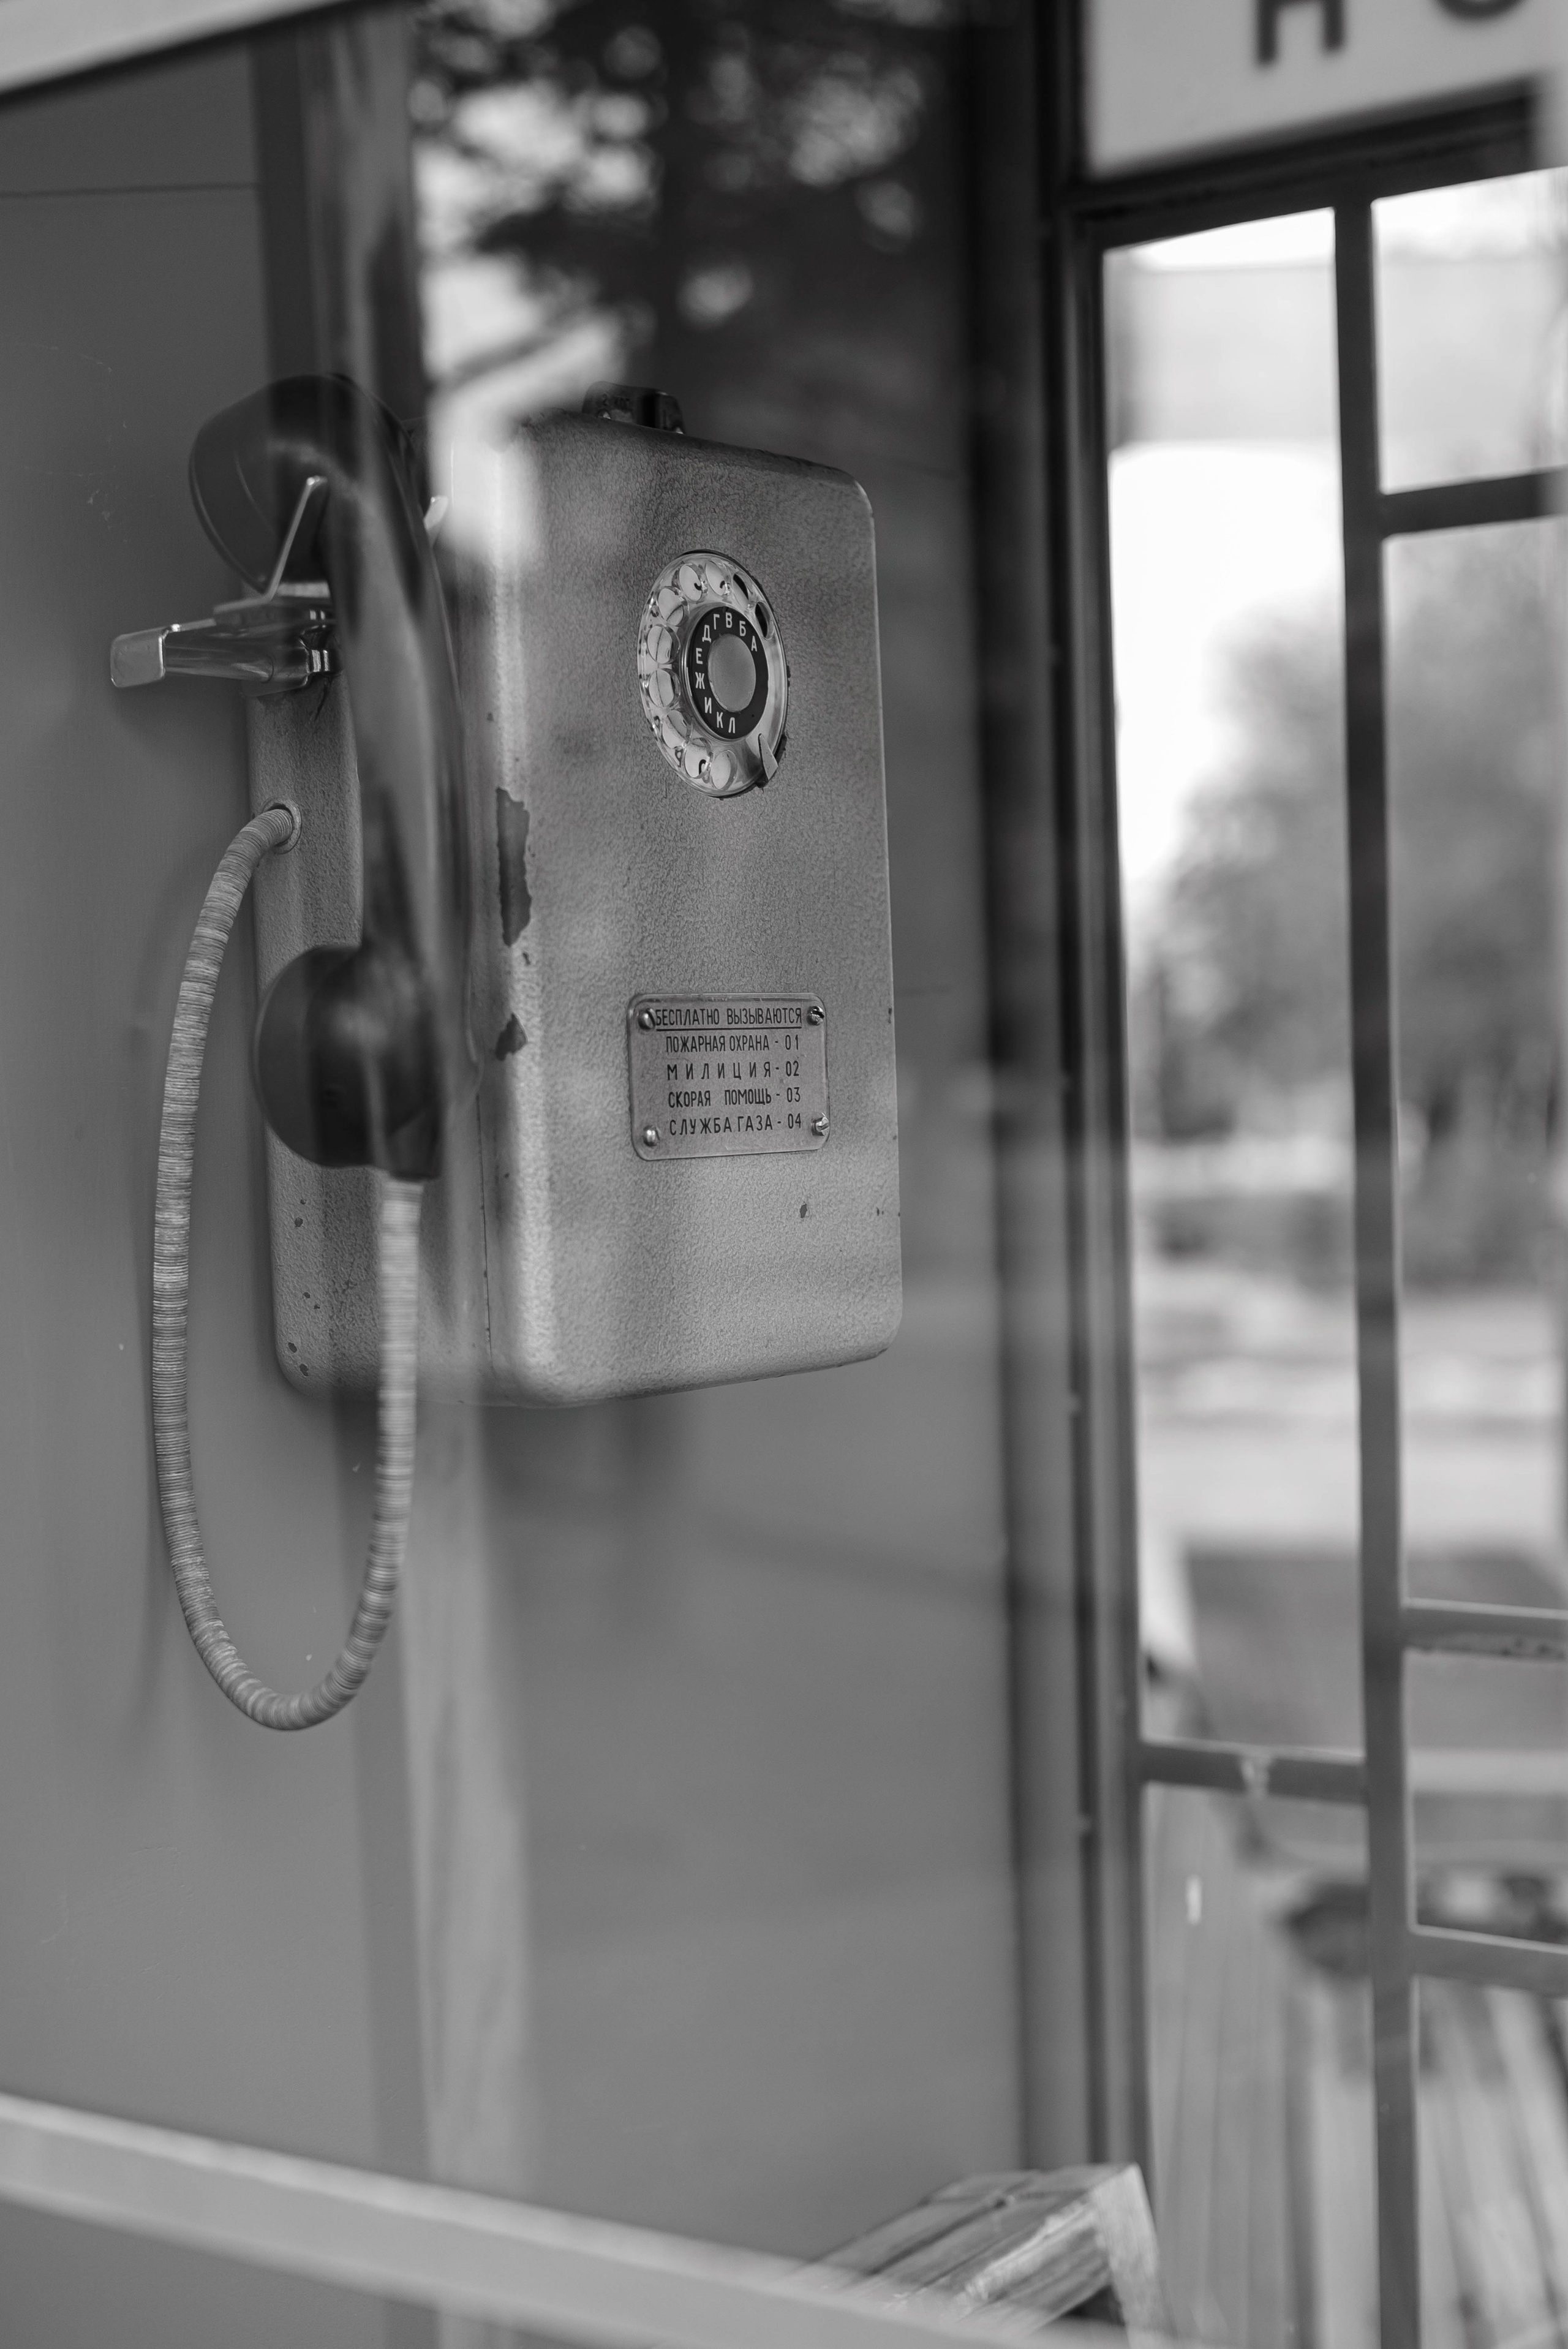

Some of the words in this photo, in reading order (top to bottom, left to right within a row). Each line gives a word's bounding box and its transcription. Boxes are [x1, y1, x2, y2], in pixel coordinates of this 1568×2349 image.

[714, 614, 720, 630] Г
[726, 613, 733, 628] В
[739, 620, 746, 636] Б
[702, 625, 711, 642] Д
[751, 636, 757, 652] А
[696, 648, 703, 664] Е
[695, 673, 705, 689] Ж
[705, 697, 712, 714] И
[717, 712, 723, 728] К
[729, 717, 735, 734] Л
[657, 1009, 720, 1026] БЕСПЛАТНО
[727, 1008, 802, 1025] ВЫЗЫВАЮТСЯ
[666, 1035, 725, 1053] ПОЖАРНАЯ
[729, 1035, 769, 1051] ОХРАНА
[785, 1035, 799, 1050] 01
[786, 1061, 799, 1077] 02
[668, 1090, 710, 1108] СКОРАЯ
[725, 1088, 772, 1106] ПОМОЩЬ
[787, 1087, 801, 1103] 03
[669, 1117, 732, 1136] СЛУЖБА
[738, 1114, 773, 1132] ГАЗА
[788, 1113, 802, 1129] 04
